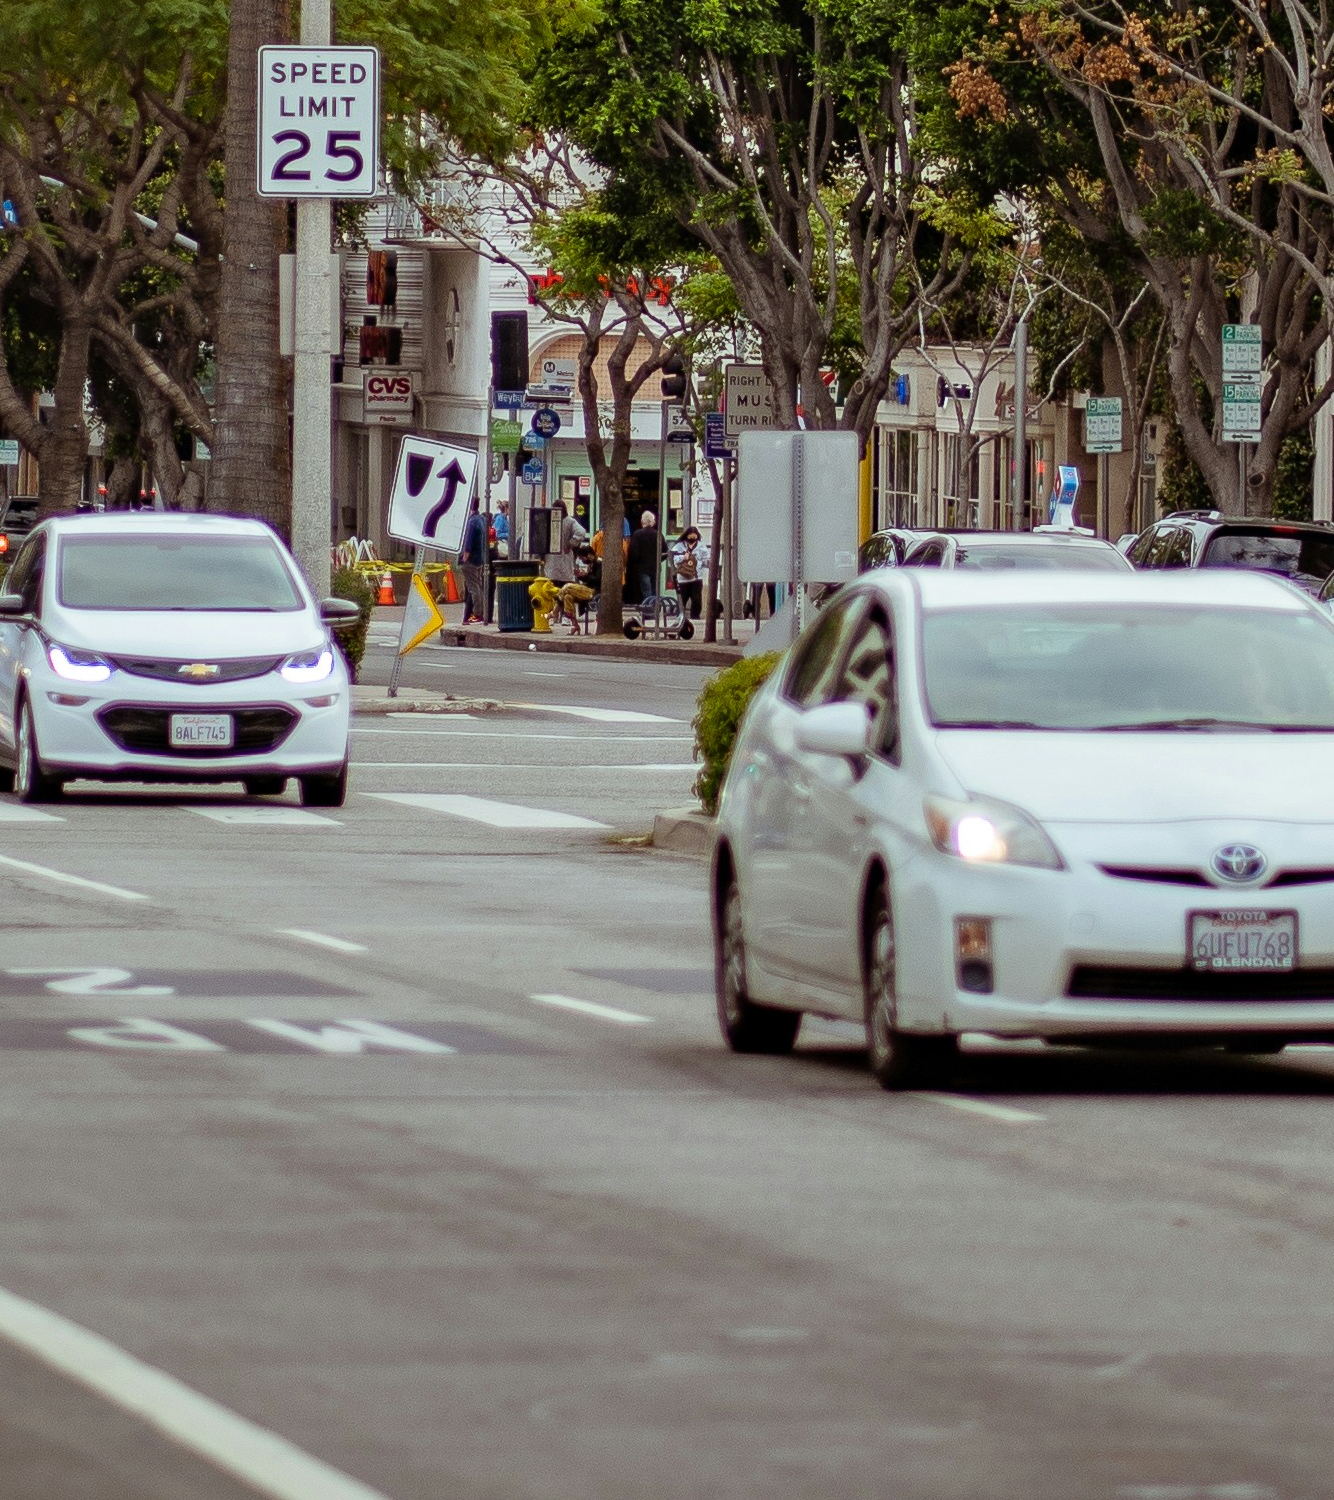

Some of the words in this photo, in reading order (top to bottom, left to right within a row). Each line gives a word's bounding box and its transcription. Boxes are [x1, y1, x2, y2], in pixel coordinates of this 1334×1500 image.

[271, 62, 366, 84] SPEED
[280, 96, 356, 118] LIMIT
[271, 129, 364, 181] 25
[1225, 326, 1234, 339] 2
[368, 377, 410, 395] CVS
[730, 375, 761, 386] RIGHT
[497, 392, 524, 404] Weybu
[1224, 385, 1235, 398] 15
[737, 394, 772, 407] MUS
[1088, 400, 1097, 412] 15
[729, 415, 757, 426] TURN
[175, 726, 226, 741] 8ALF745
[1220, 911, 1266, 921] TOYOTA
[1197, 931, 1290, 958] 6UFU768
[1212, 957, 1292, 968] GLENDALE
